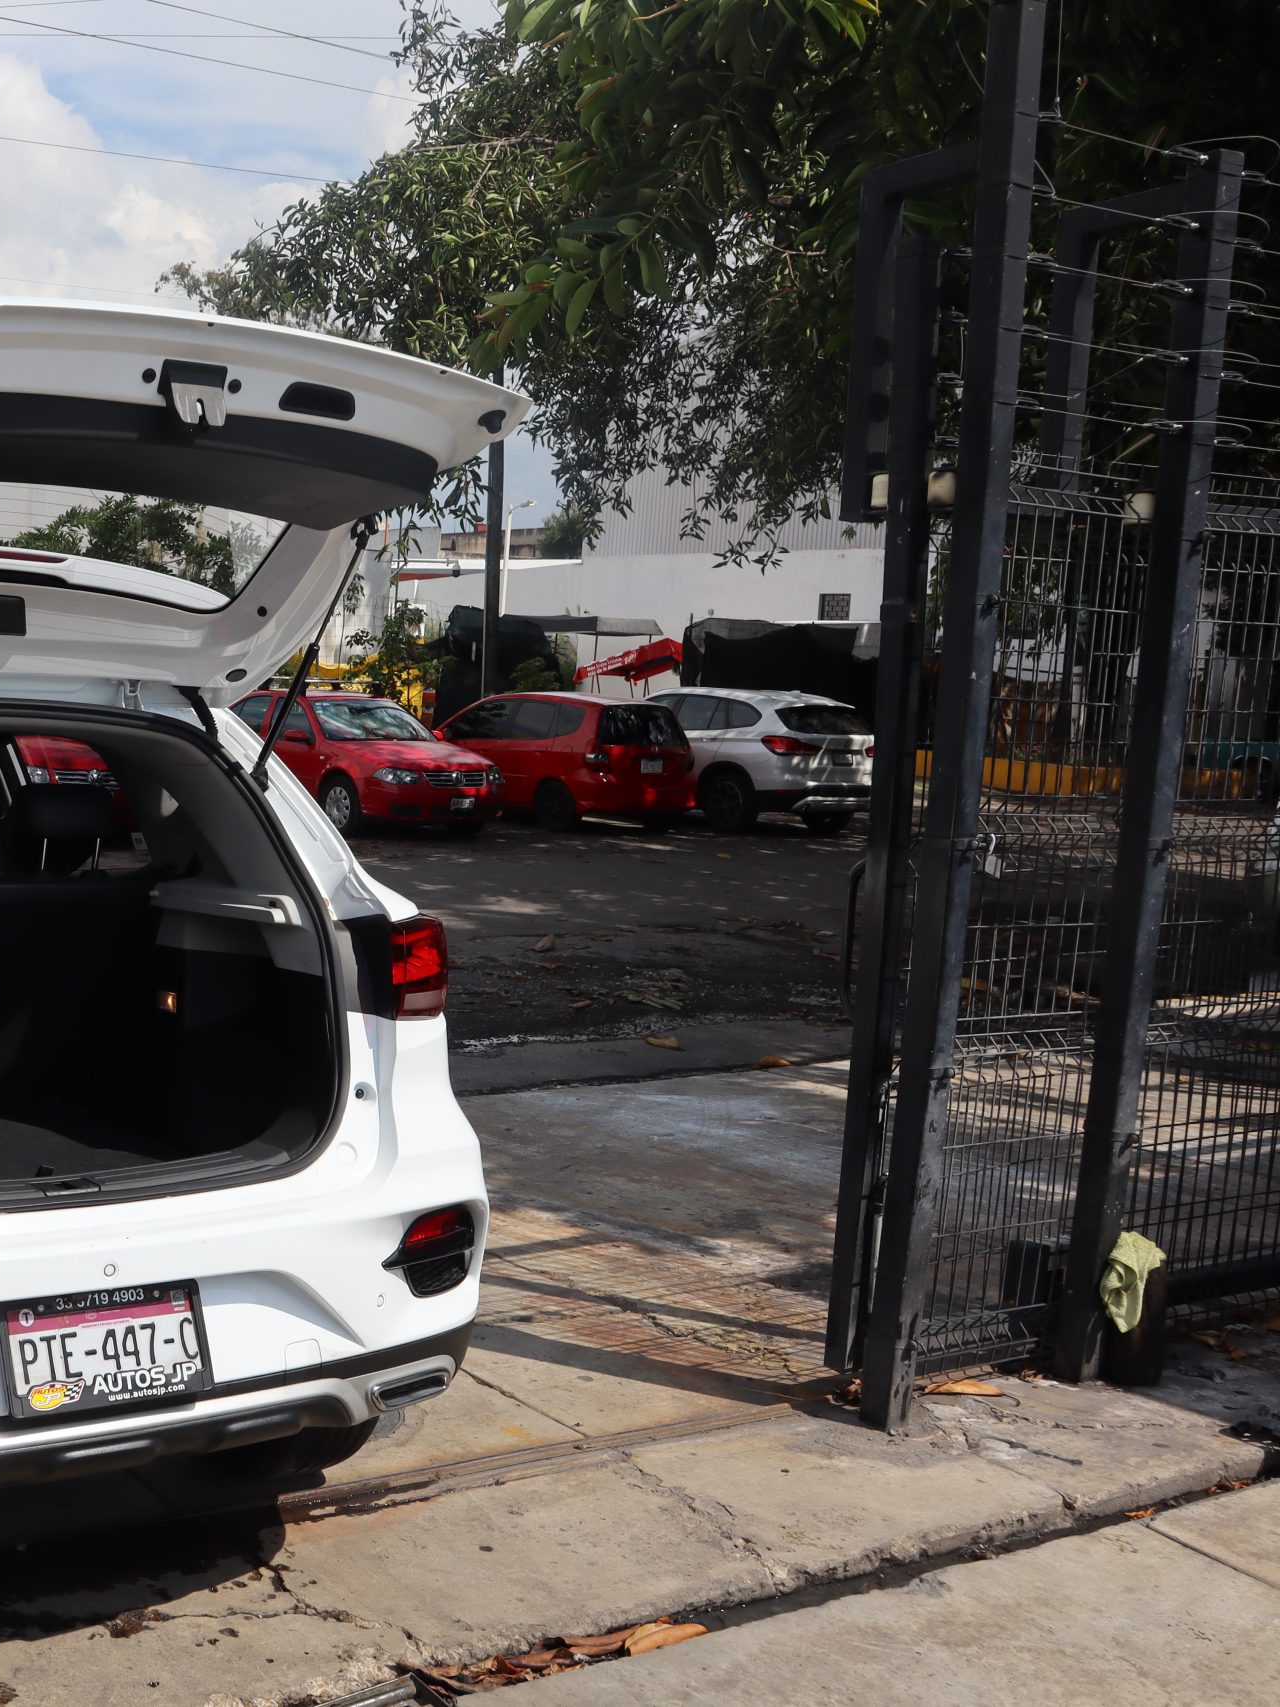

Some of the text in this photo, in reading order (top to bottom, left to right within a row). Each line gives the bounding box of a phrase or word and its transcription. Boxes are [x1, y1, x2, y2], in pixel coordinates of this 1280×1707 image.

[112, 1288, 145, 1303] 4903
[18, 1316, 199, 1385] PTE-447-C
[93, 1362, 197, 1395] AUTOS JP
[33, 1386, 65, 1395] AUTOS
[35, 1392, 62, 1406] JP
[108, 1383, 186, 1402] www.autosjp.com
